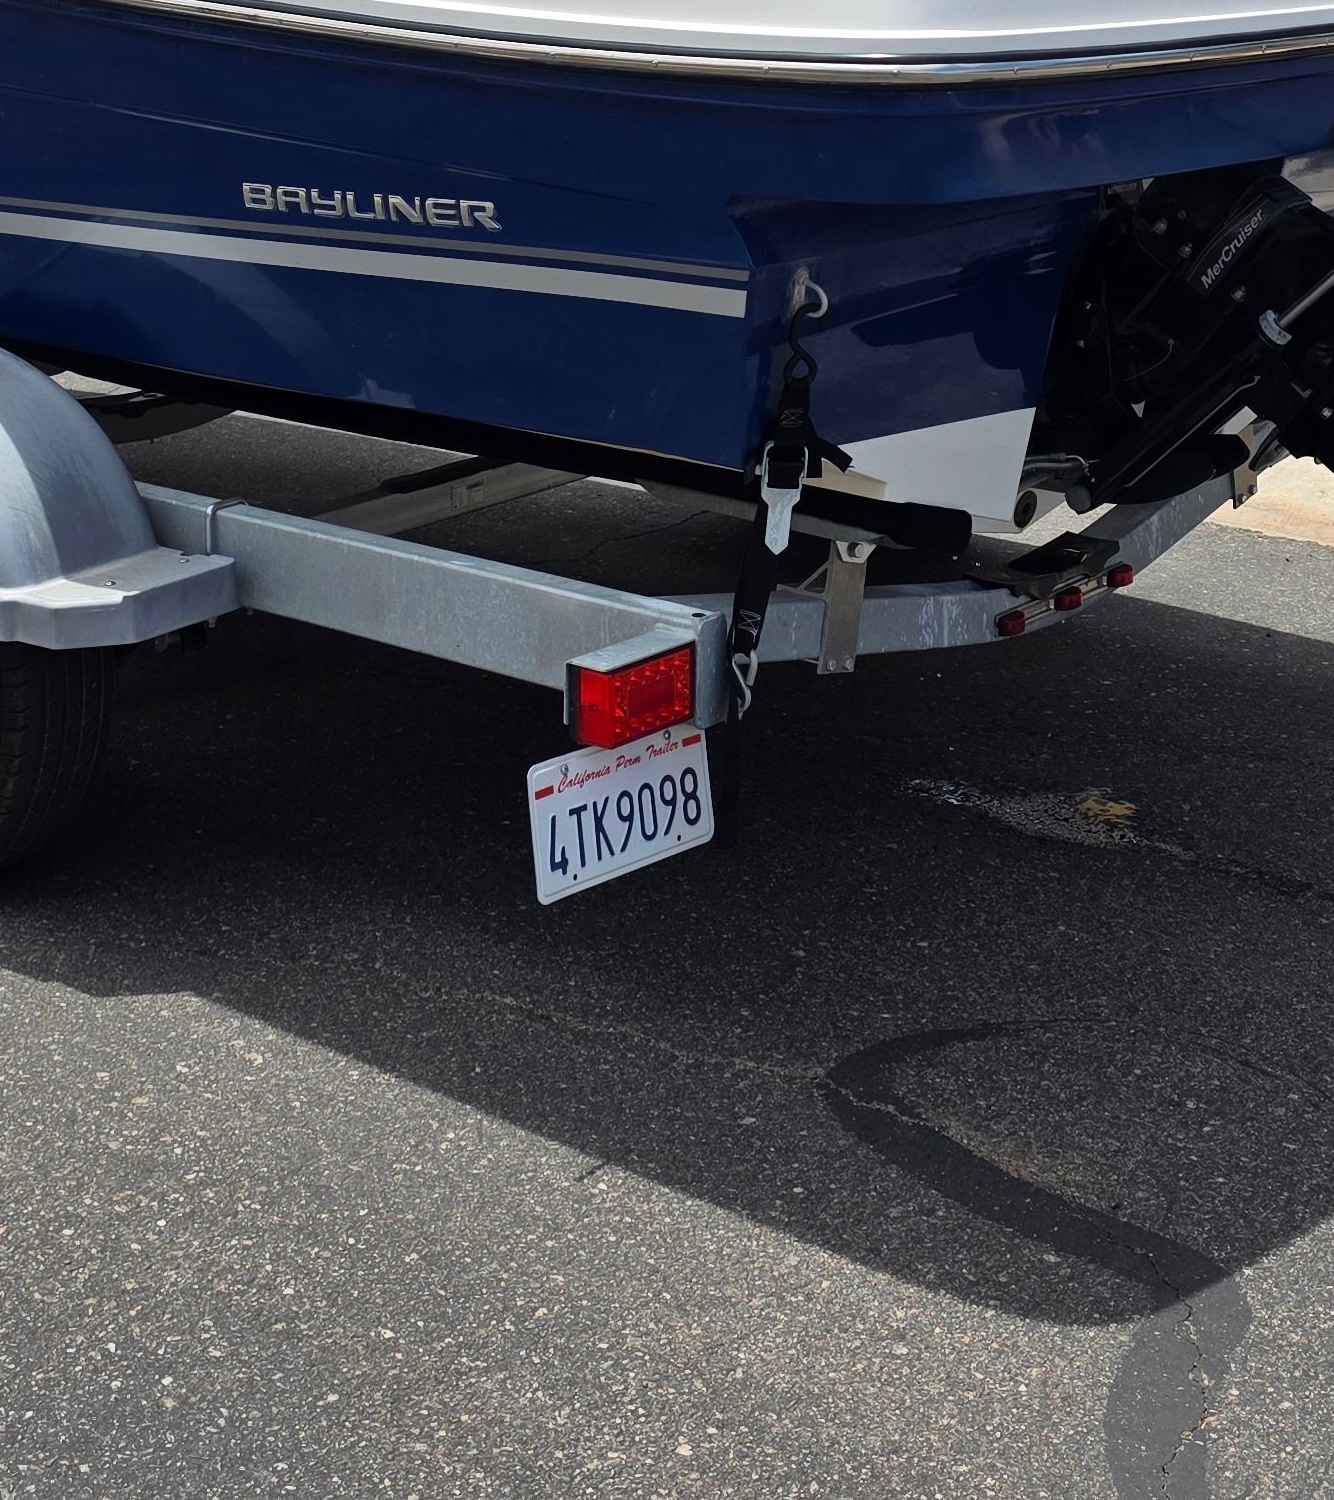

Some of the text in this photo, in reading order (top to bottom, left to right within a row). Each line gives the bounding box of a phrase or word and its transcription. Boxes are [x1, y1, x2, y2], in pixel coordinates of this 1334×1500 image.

[242, 182, 503, 232] BAYLINER
[1201, 209, 1264, 290] MerCruiser
[557, 737, 680, 794] California Perm Trailer
[549, 767, 702, 876] 4TK9098
